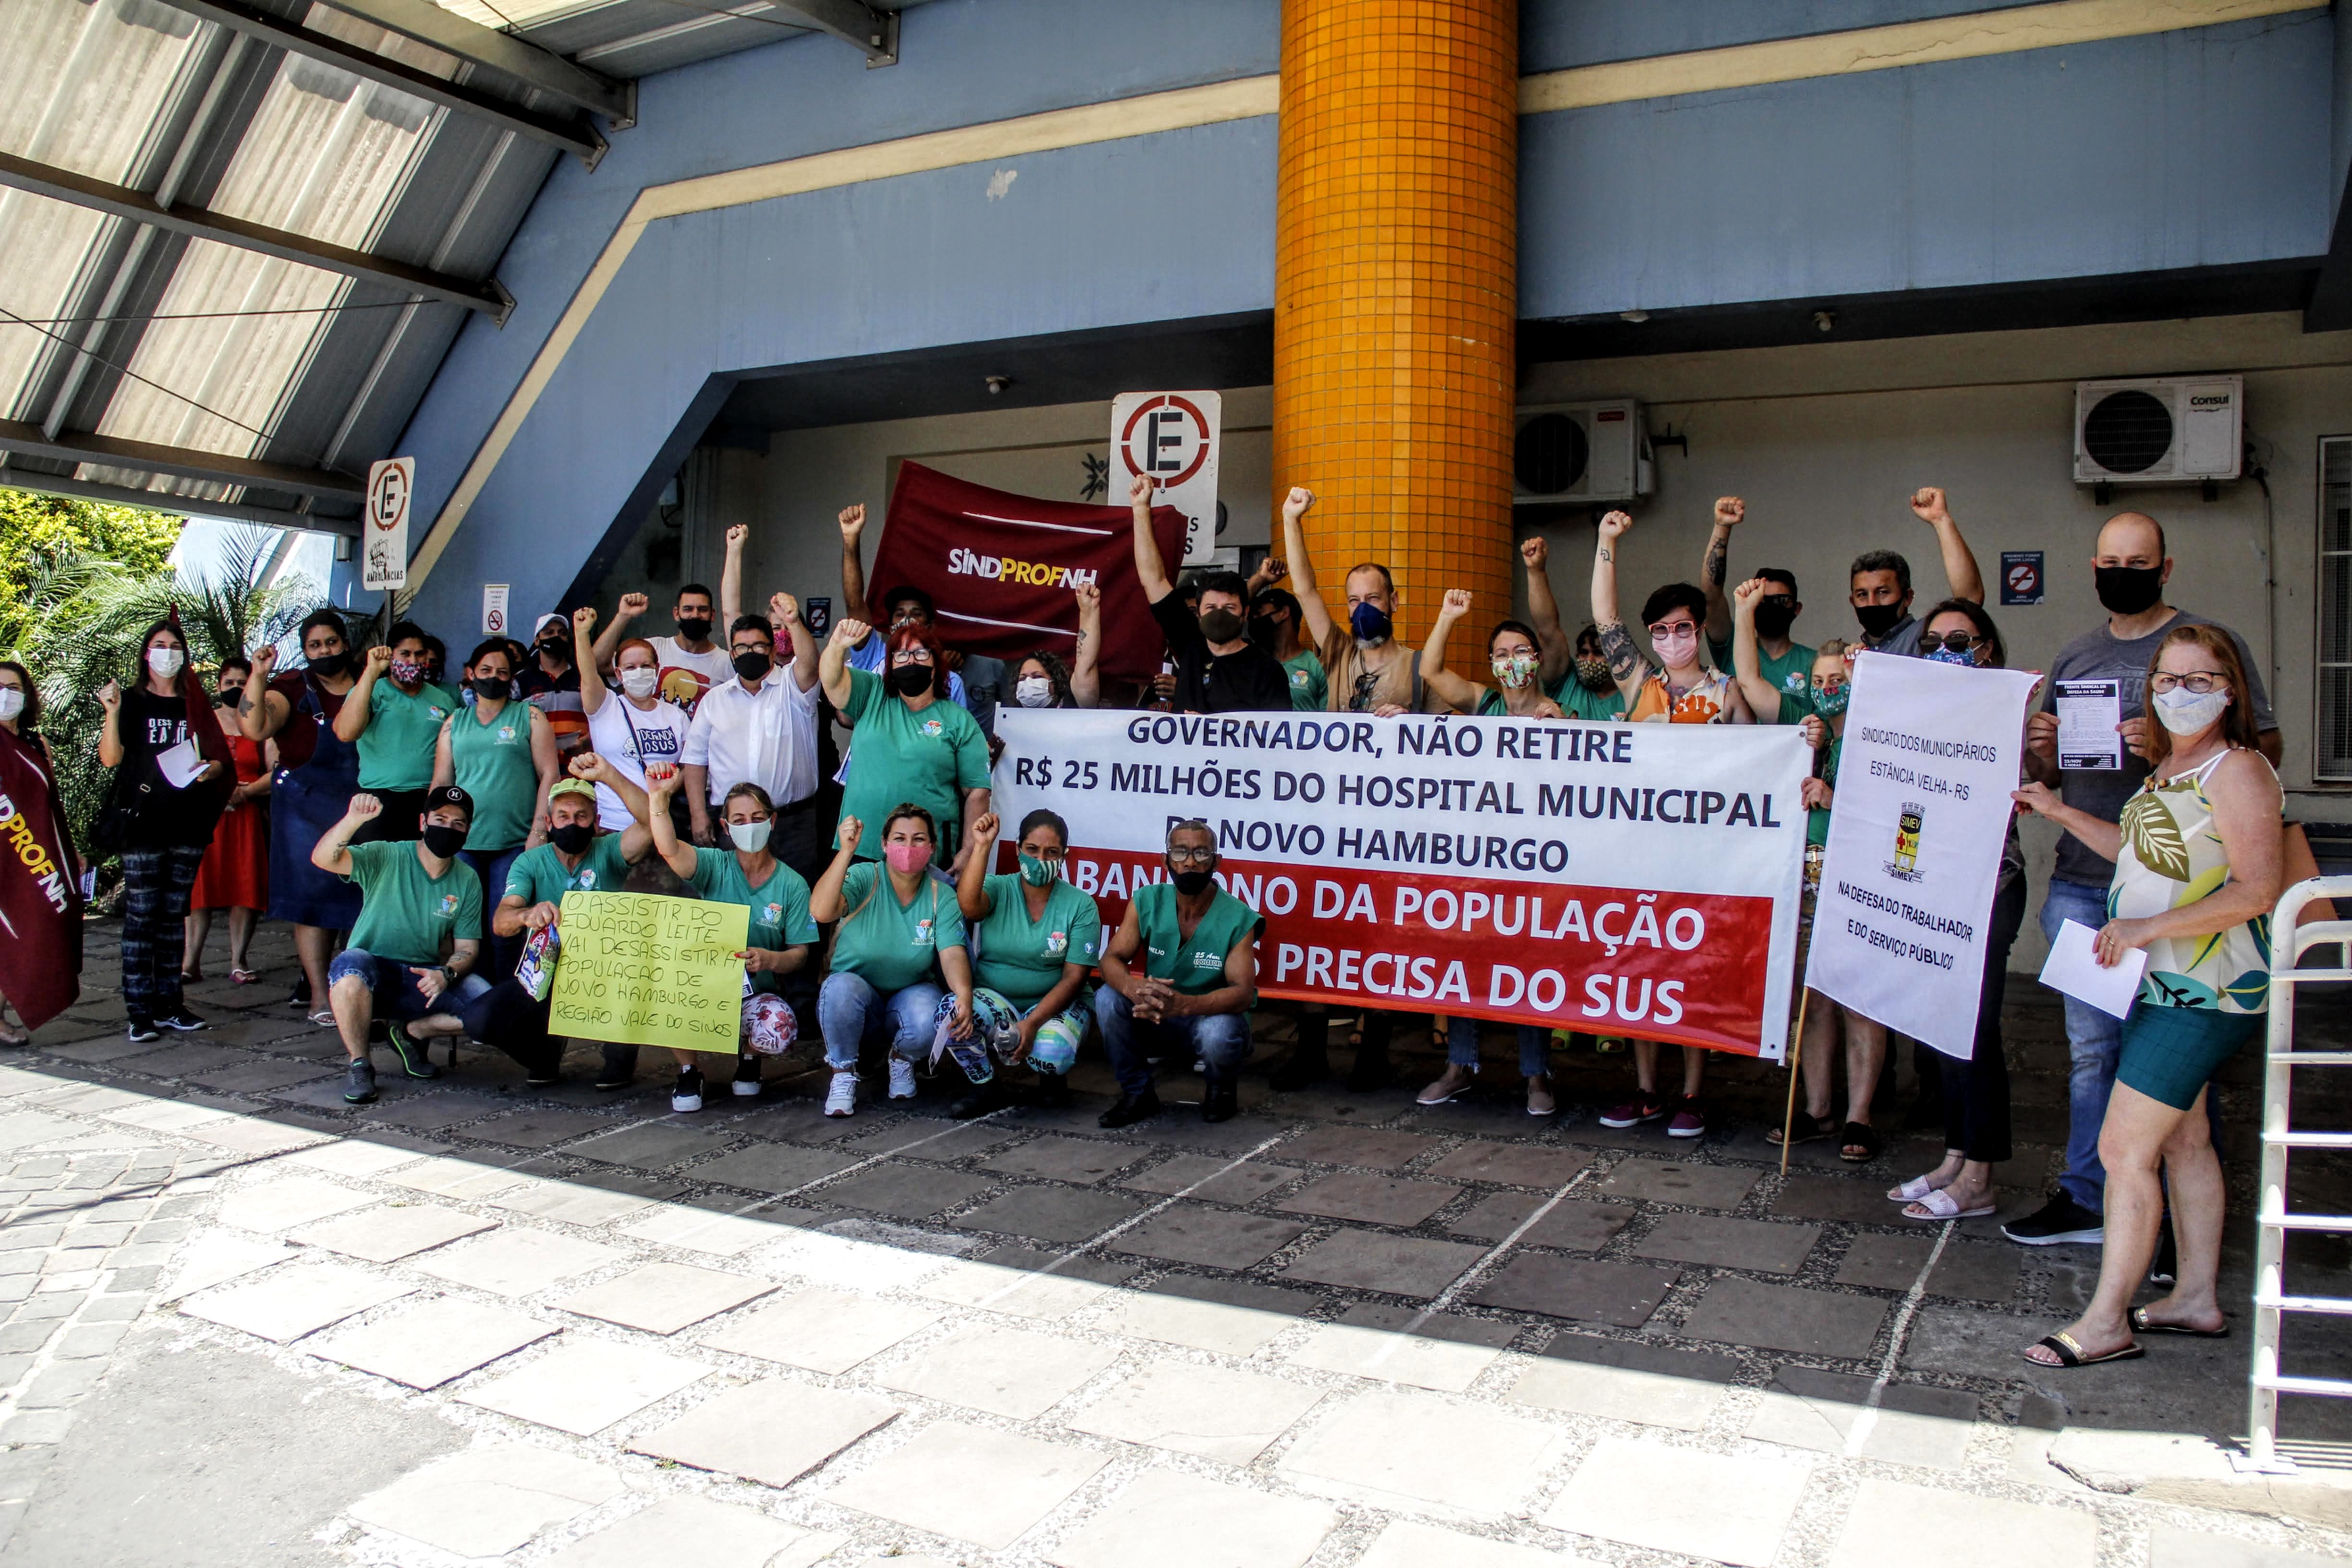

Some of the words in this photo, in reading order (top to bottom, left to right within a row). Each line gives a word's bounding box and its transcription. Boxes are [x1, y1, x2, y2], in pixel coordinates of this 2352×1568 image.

[2191, 395, 2229, 405] Consul
[1147, 412, 1183, 471] E
[1128, 717, 1383, 759] GOVERNADOR,
[1397, 716, 1483, 757] NÃO
[1496, 727, 1633, 763] RETIRE
[1862, 727, 1899, 747] SINDICATO
[1901, 734, 1920, 751] DOS
[1921, 738, 1997, 762] MUNICIPÁRIOS
[1016, 756, 1052, 790] R$
[1063, 760, 1098, 790] 25
[1111, 759, 1261, 799] MILHÕES
[1274, 771, 1325, 803] DO
[1339, 774, 1524, 814] HOSPITAL
[1538, 784, 1781, 828] MUNICIPAL
[1870, 761, 1915, 785] ESTÂNCIA
[1918, 773, 1947, 795] VELHA
[1954, 783, 1969, 801] RS
[1900, 816, 1921, 829] SIMEV
[1219, 819, 1325, 856] NOVO
[1337, 827, 1569, 873] HAMBURGO
[1891, 868, 1913, 882] SIMEV
[568, 893, 584, 910] O
[590, 895, 681, 921] ASSISTIR
[691, 907, 722, 926] DO
[1312, 880, 1378, 924] DA
[1394, 886, 1705, 957] POPULAÇÃO
[1838, 881, 1849, 898] NA
[1851, 886, 1884, 911] DEFESA
[1886, 898, 1899, 914] DO
[1901, 904, 1973, 942] TRABALHADOR
[561, 913, 657, 937] EDUARDO
[667, 922, 719, 943] LEITE
[1848, 919, 1854, 933] E
[1855, 922, 1867, 938] DO
[1868, 930, 1906, 957] SERVIÇO
[1909, 943, 1953, 970] PÚBLICO
[1149, 946, 1165, 956] HELIO
[558, 978, 606, 997] NOVO
[618, 984, 709, 1009] HAMBURGO
[676, 971, 703, 986] DE
[1276, 943, 1471, 1003] PRECISA
[1489, 964, 1566, 1012] DO
[1582, 973, 1685, 1025] SUS
[621, 1009, 658, 1027] VALE
[667, 1014, 683, 1029] DO
